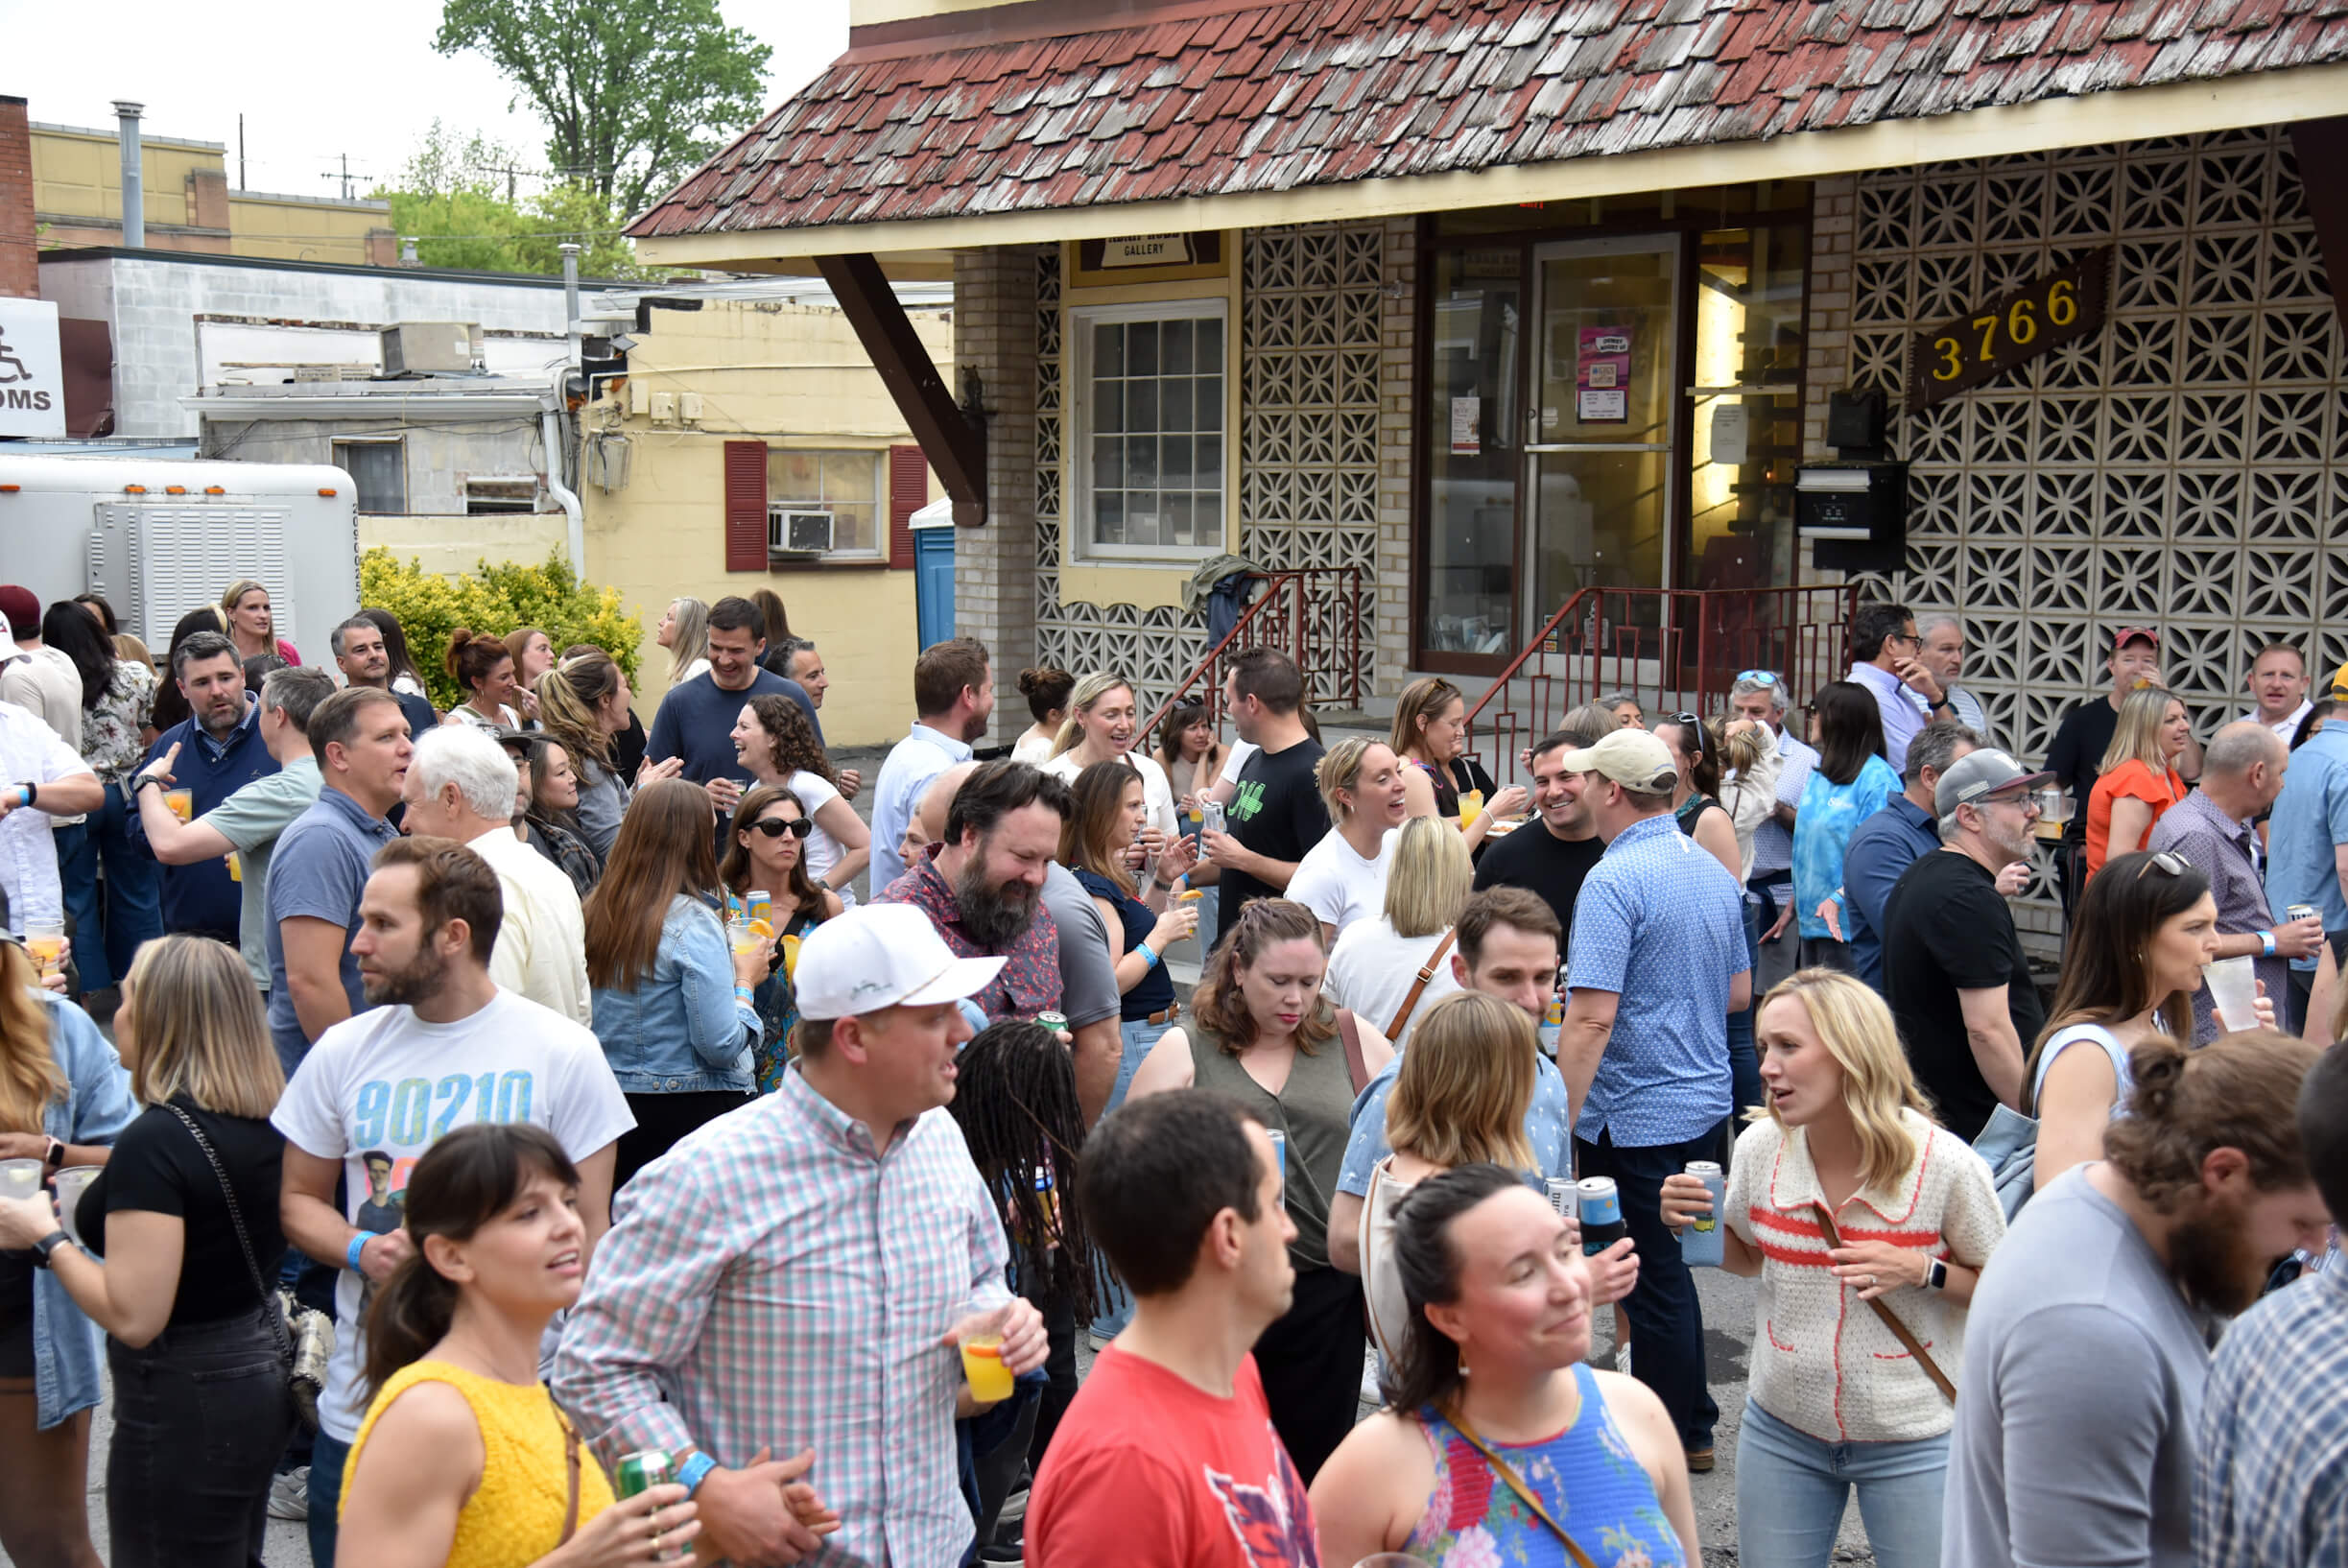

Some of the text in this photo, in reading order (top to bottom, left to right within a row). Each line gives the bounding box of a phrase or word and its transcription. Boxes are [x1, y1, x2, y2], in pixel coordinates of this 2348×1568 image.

[1125, 243, 1164, 256] GALLERY
[1933, 280, 2077, 380] 3766
[354, 1069, 534, 1149] 90210
